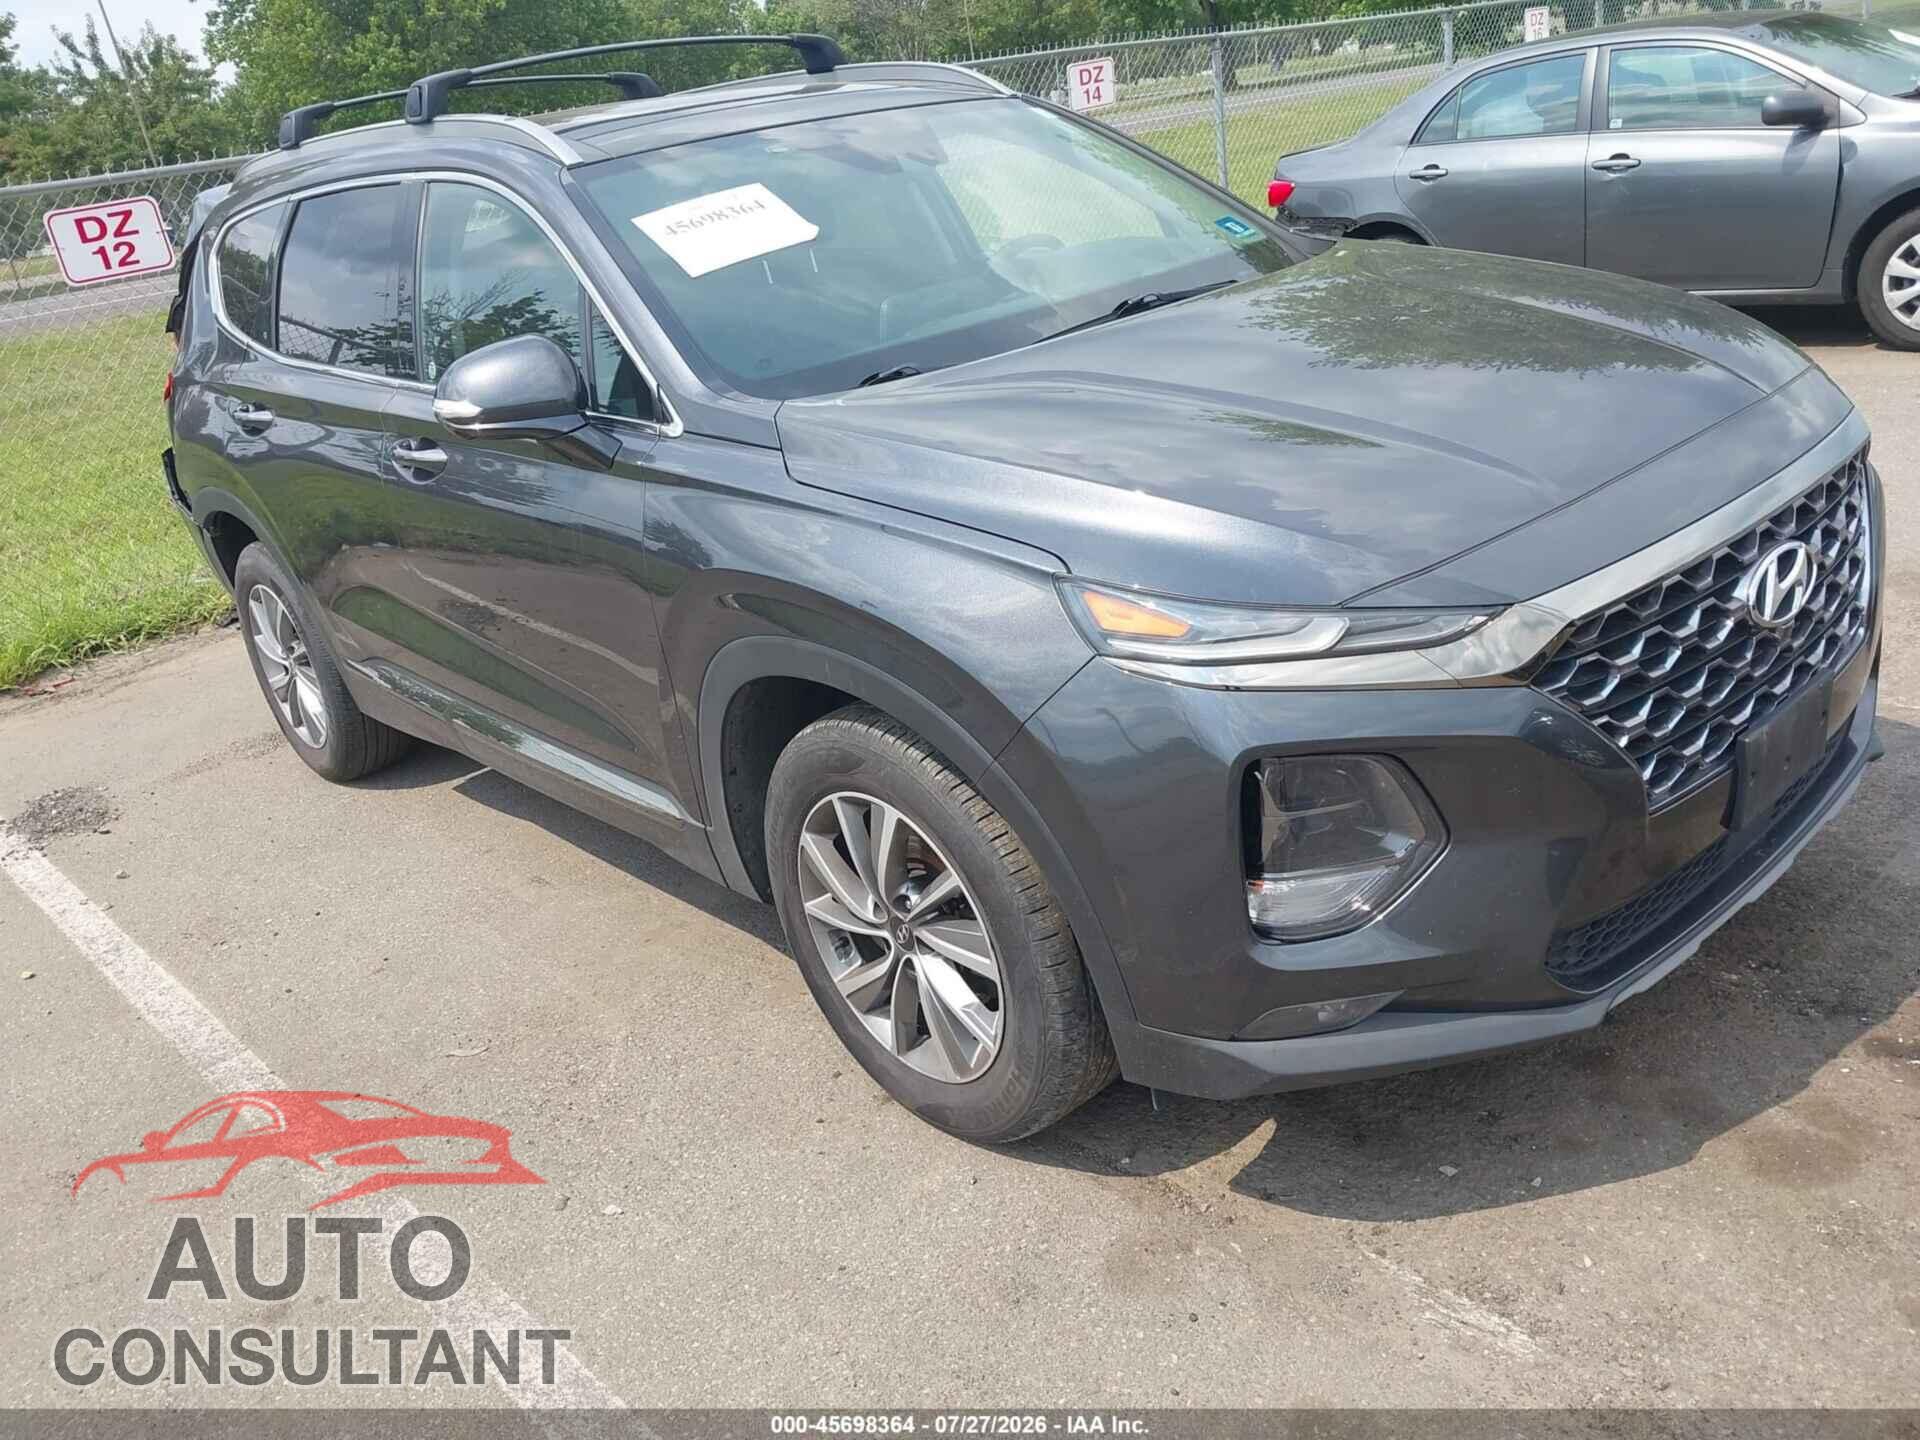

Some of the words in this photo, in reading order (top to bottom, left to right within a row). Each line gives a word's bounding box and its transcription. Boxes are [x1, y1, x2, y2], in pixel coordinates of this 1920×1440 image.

[1531, 12, 1544, 26] DZ
[1079, 65, 1104, 86] DZ
[1083, 86, 1102, 104] 14
[74, 209, 140, 244] DZ
[91, 241, 141, 270] 12
